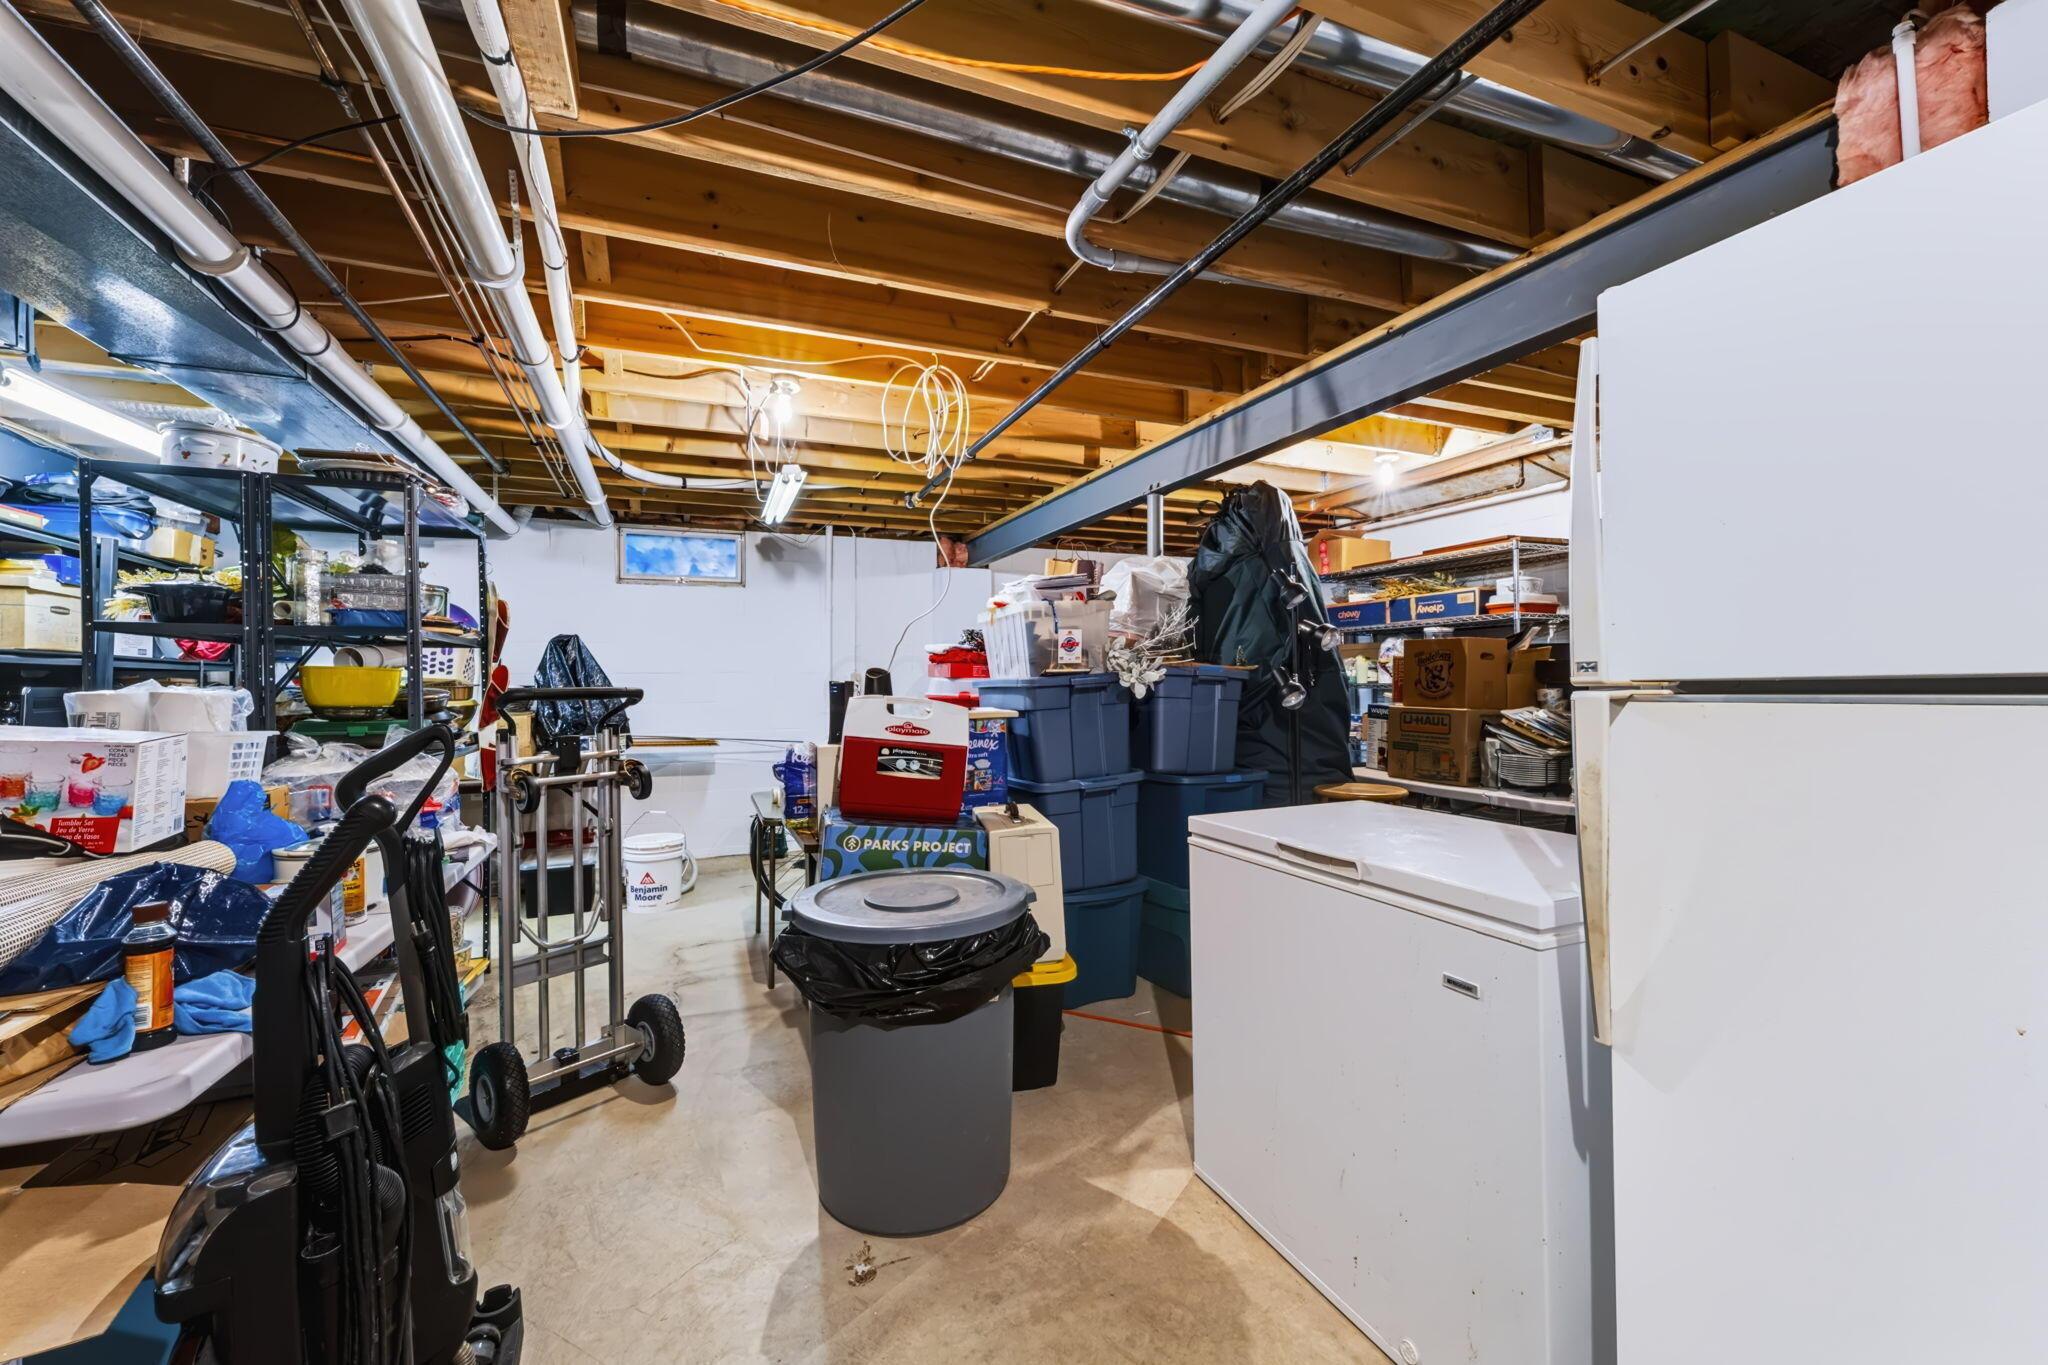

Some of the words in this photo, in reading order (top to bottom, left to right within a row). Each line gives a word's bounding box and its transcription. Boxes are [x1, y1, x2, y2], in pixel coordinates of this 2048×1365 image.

[1403, 714, 1448, 727] U-HAUL
[887, 726, 929, 735] playmate
[969, 739, 999, 751] eenex
[792, 805, 804, 814] 12
[56, 826, 68, 834] Jeu
[863, 838, 909, 851] PARKS
[913, 841, 972, 854] PROJECT
[630, 885, 668, 895] Benjamin
